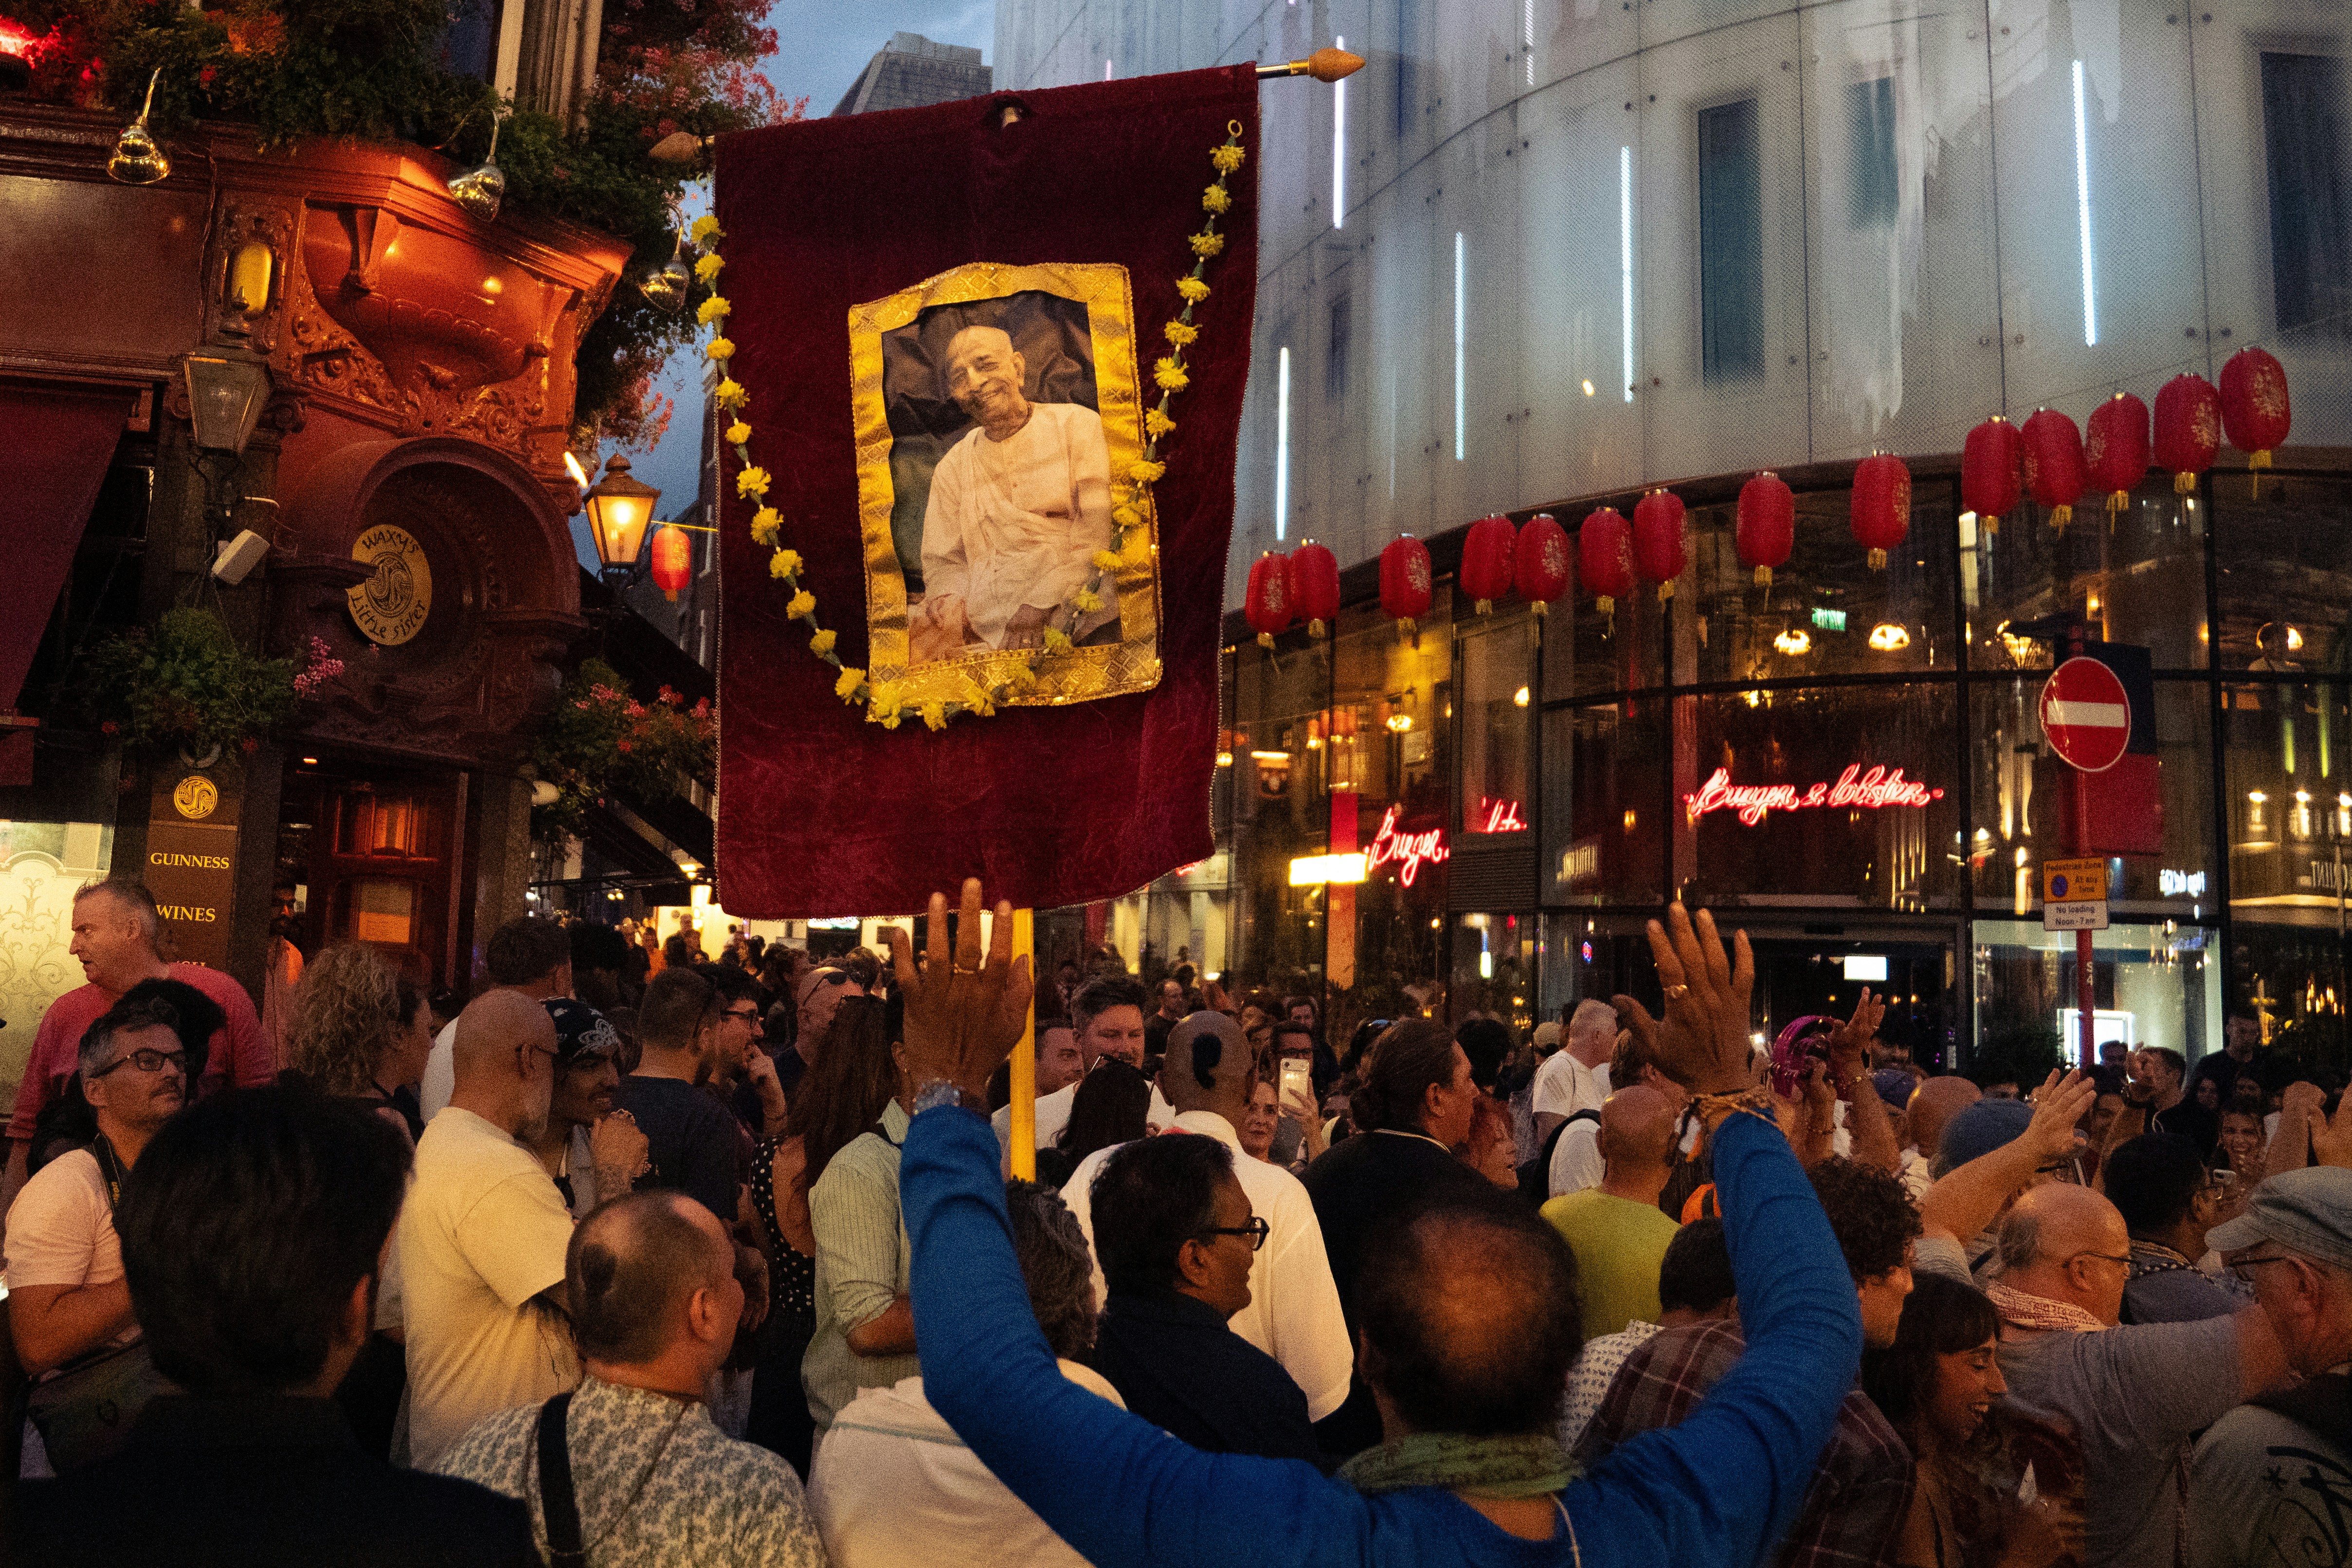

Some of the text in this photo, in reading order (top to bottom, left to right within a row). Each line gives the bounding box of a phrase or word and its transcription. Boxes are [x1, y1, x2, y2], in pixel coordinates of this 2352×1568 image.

[1688, 767, 1800, 827] Burger
[1801, 782, 1827, 807] &
[150, 852, 229, 869] GUINNESS
[2084, 861, 2102, 869] Zone
[156, 905, 216, 922] WINES
[2068, 905, 2095, 914] loading
